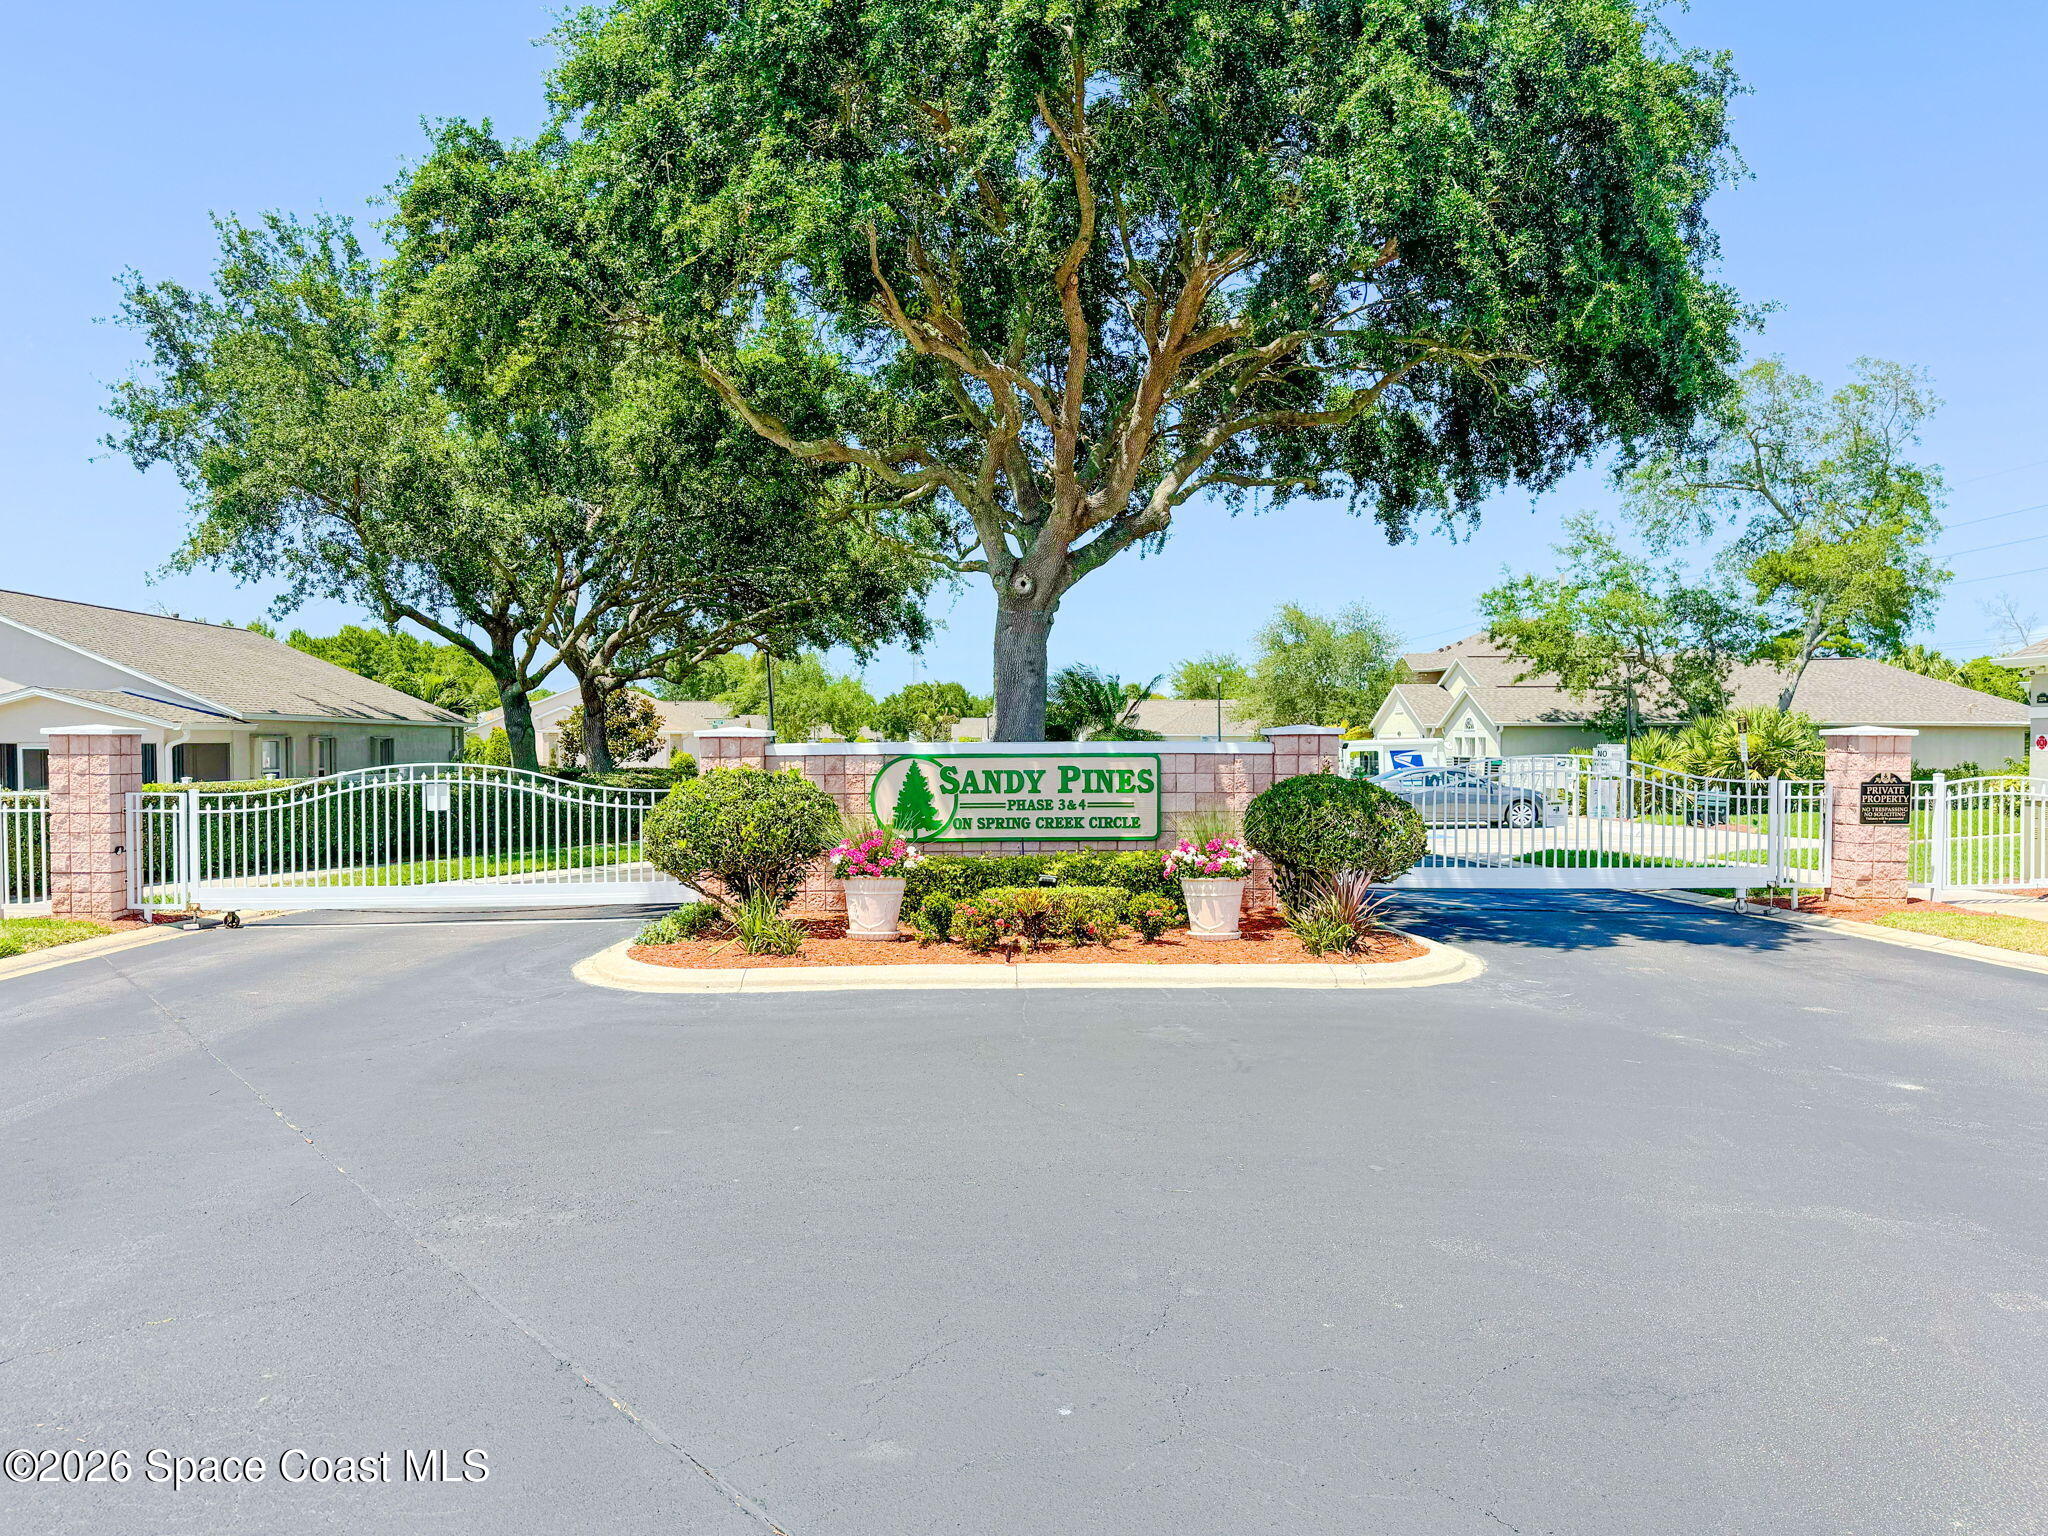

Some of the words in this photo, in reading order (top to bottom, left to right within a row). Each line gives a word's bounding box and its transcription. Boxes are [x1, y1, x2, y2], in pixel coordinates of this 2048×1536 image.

[1597, 750, 1608, 758] NO
[939, 765, 1046, 795] SANDY
[1057, 765, 1155, 794] PINES
[1866, 786, 1905, 795] PRIVATE
[1862, 795, 1910, 803] PROPERTY
[1006, 799, 1054, 811] PHASE
[953, 817, 972, 830] ON
[977, 817, 1031, 830] SPRING
[1036, 817, 1084, 829] CREEK
[1088, 816, 1141, 829] CIRCLE
